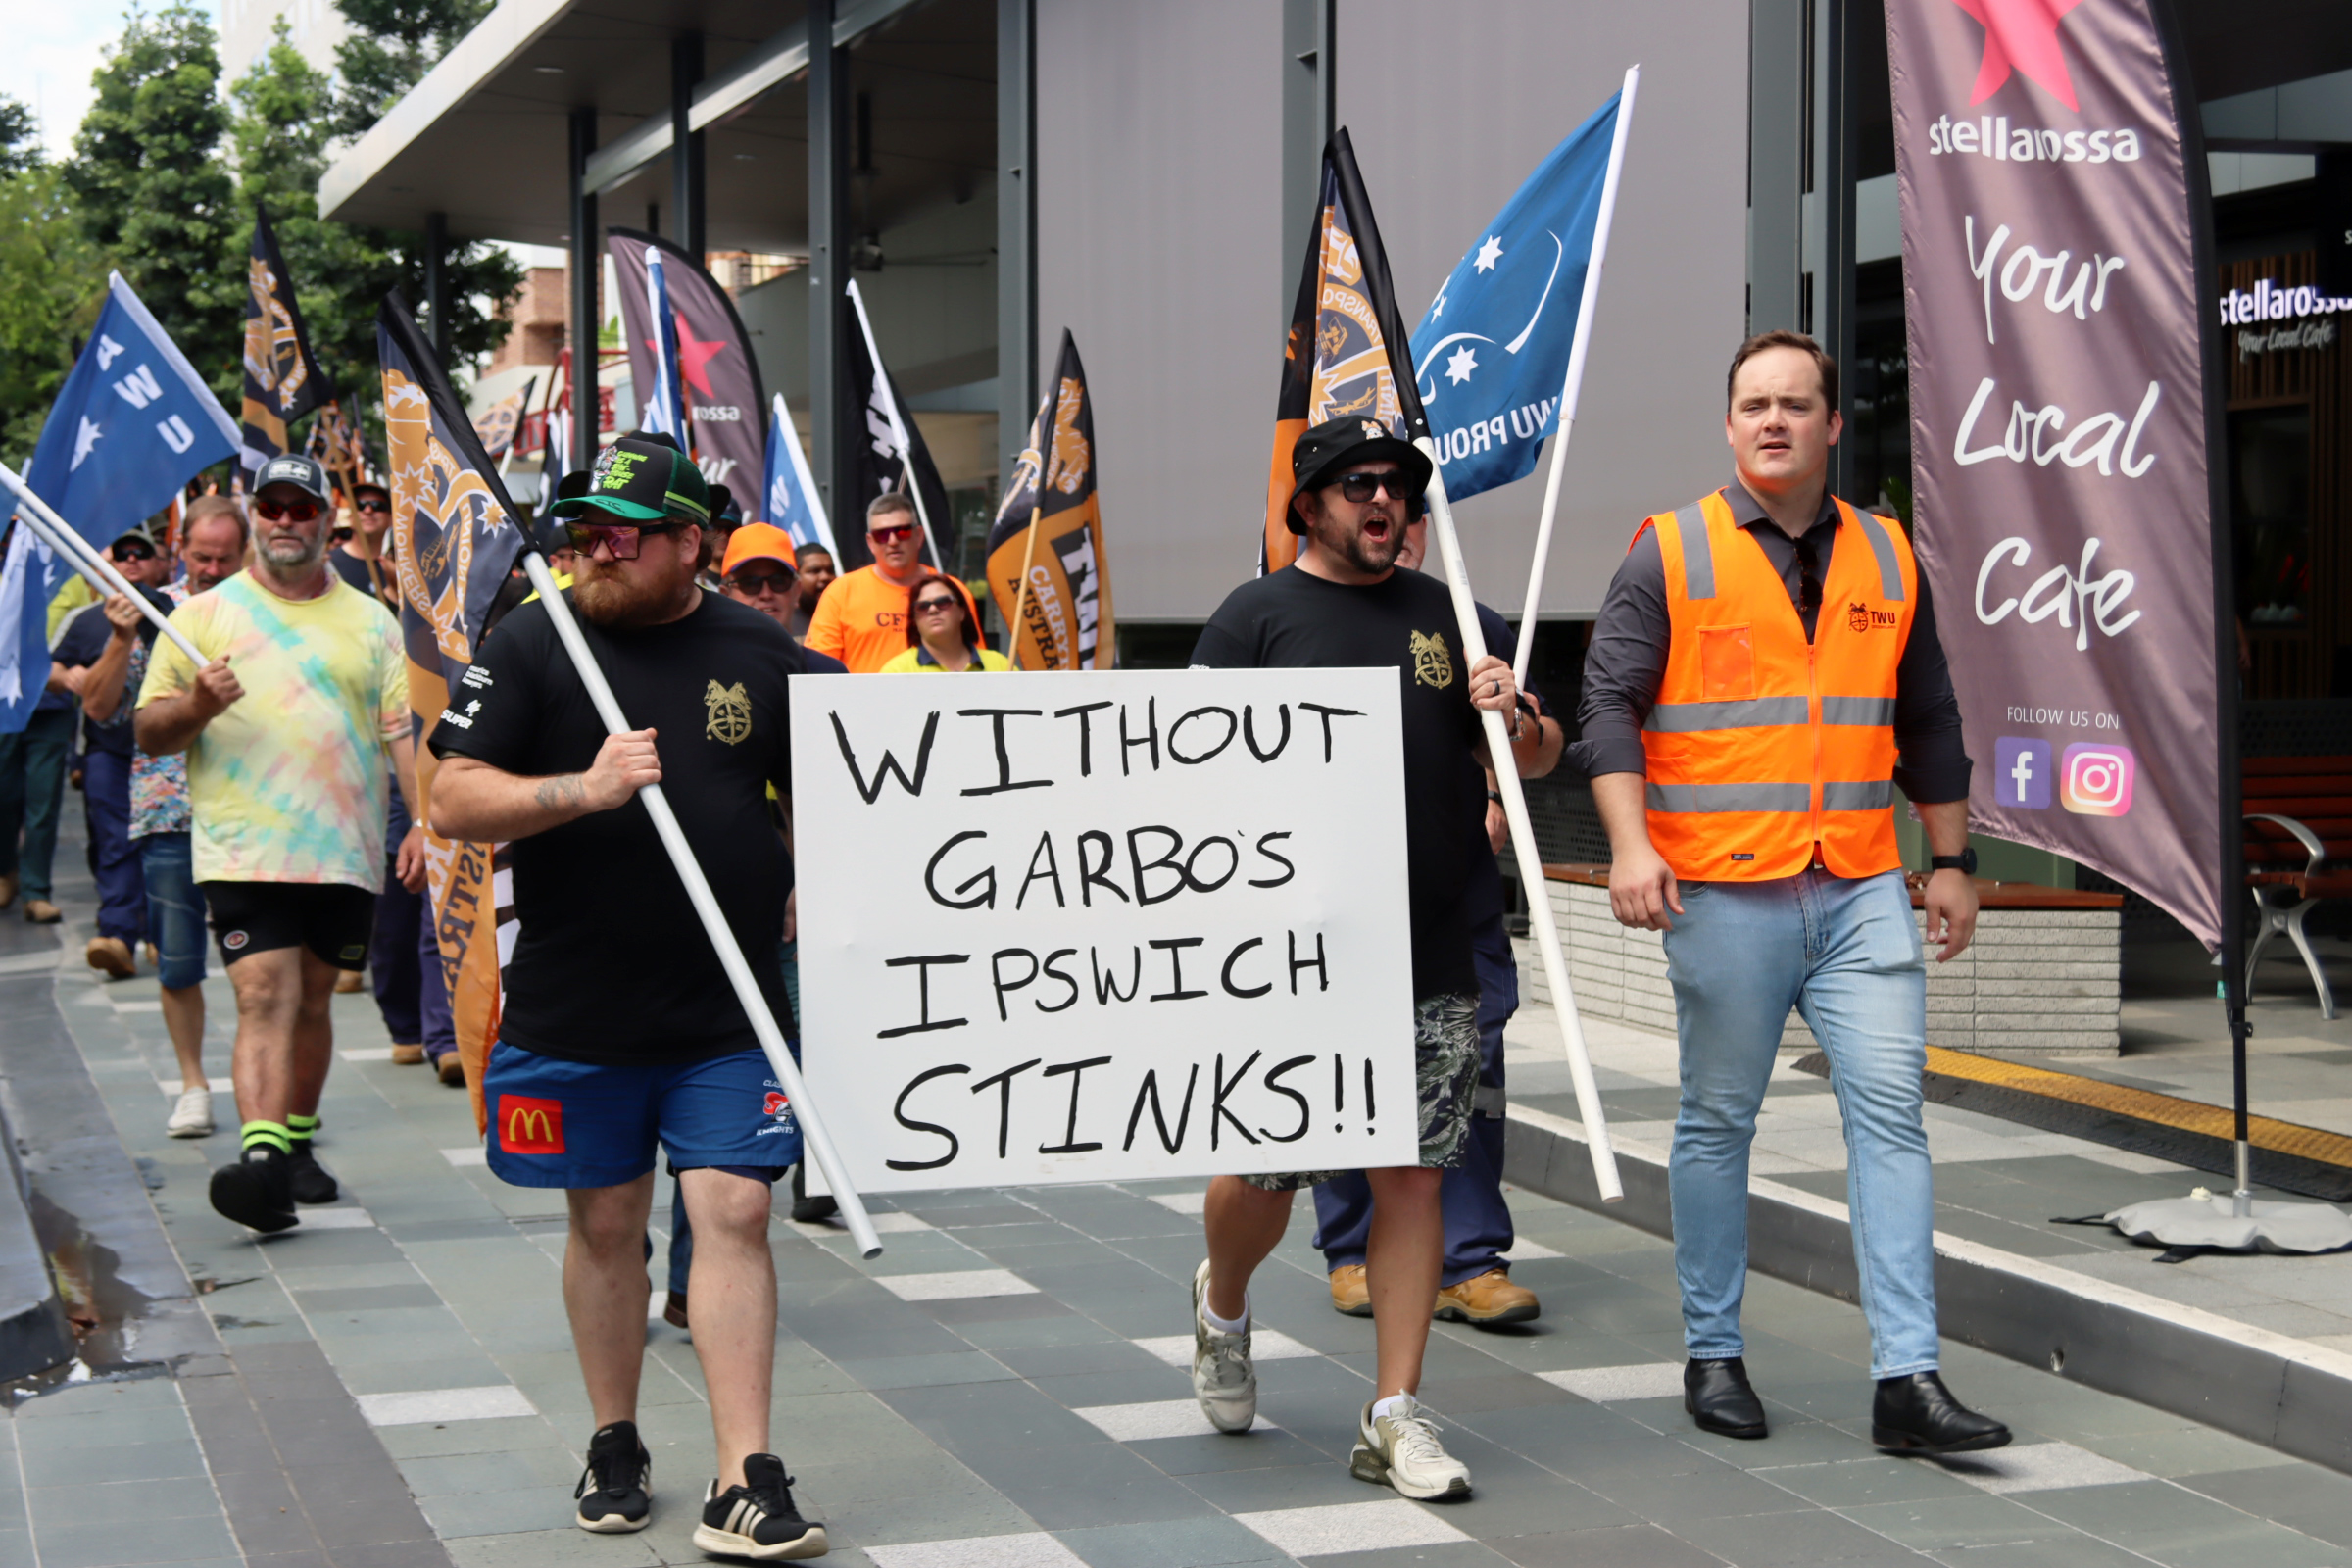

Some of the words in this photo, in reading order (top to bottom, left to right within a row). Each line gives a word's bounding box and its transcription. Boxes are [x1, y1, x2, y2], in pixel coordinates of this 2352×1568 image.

[1929, 114, 2140, 164] stellarossa
[1965, 215, 2124, 345] Your
[1953, 376, 2159, 479] Local
[1871, 611, 1896, 624] TWU
[1975, 536, 2142, 652] Cafe
[440, 709, 473, 729] SUPER
[828, 695, 1368, 805] WITHOUT
[2007, 706, 2064, 725] FOLLOW
[2070, 710, 2089, 727] US
[2095, 712, 2119, 730] ON
[924, 825, 1296, 910] GARBO'S
[877, 930, 1329, 1039] IPSWICH
[756, 1125, 794, 1136] KNIGHTS
[885, 1050, 1376, 1171] STINKS!!
